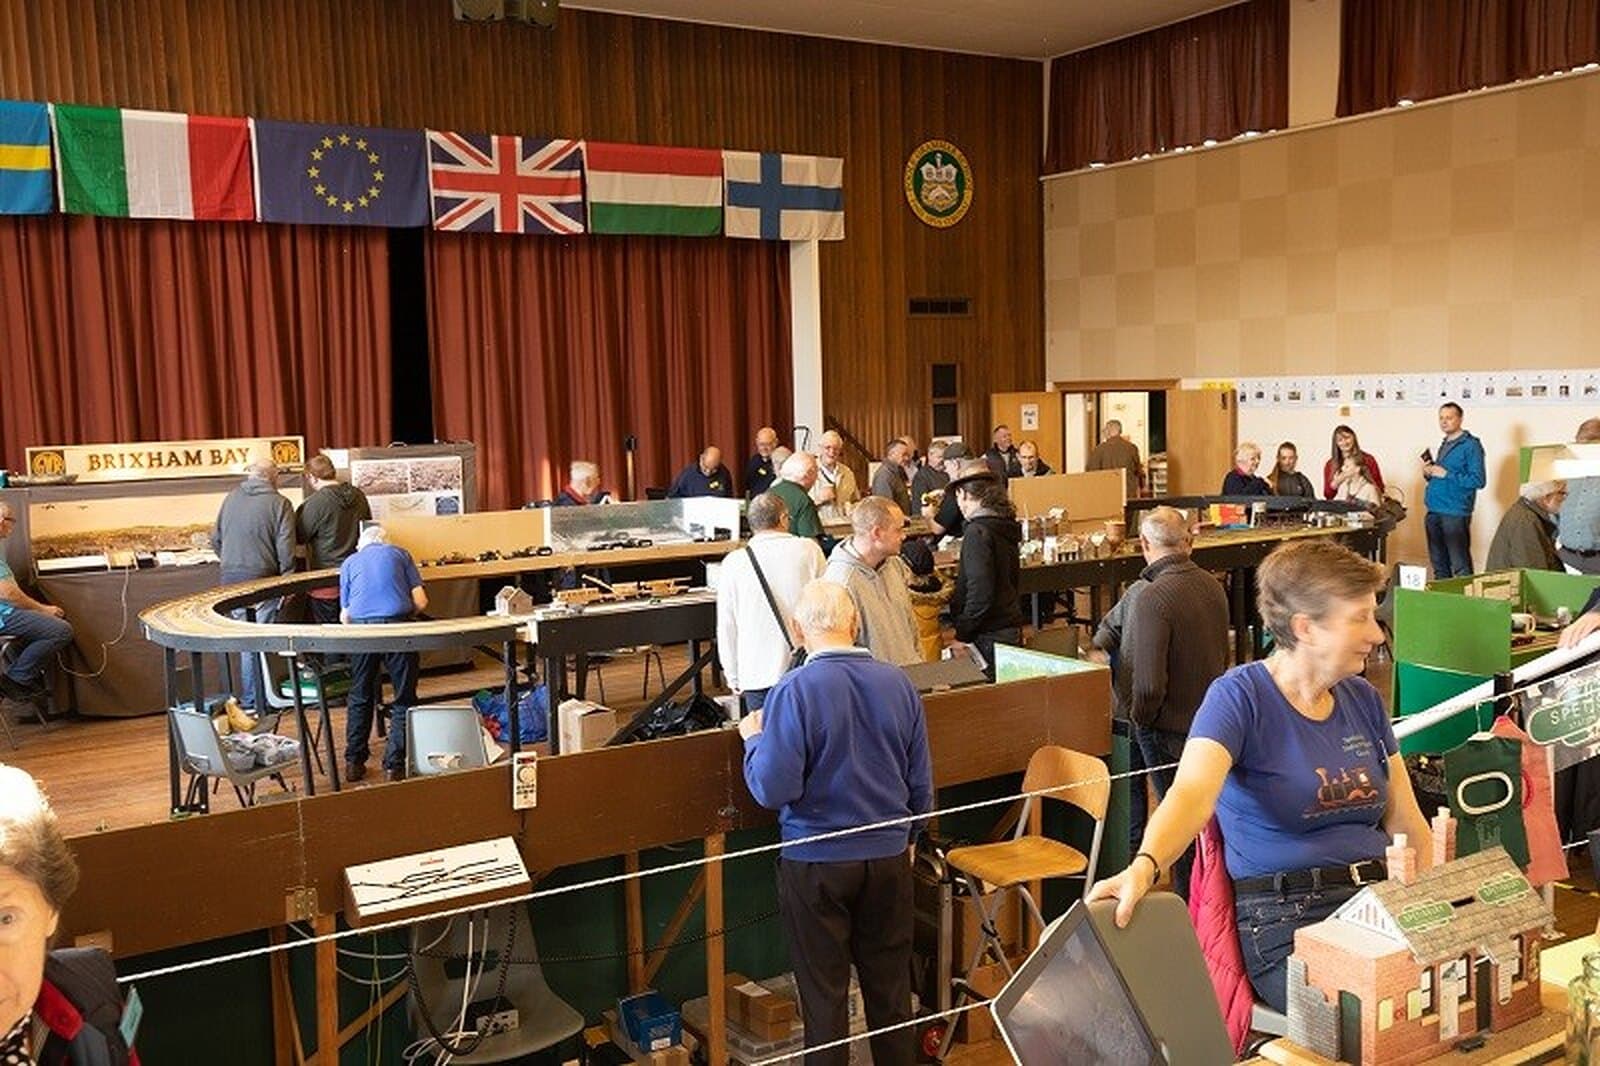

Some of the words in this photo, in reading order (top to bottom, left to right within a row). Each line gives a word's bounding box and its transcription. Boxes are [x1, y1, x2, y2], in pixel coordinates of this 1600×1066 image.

[88, 450, 203, 472] BRIXHAM
[210, 448, 251, 466] BAY
[1405, 574, 1420, 587] 18
